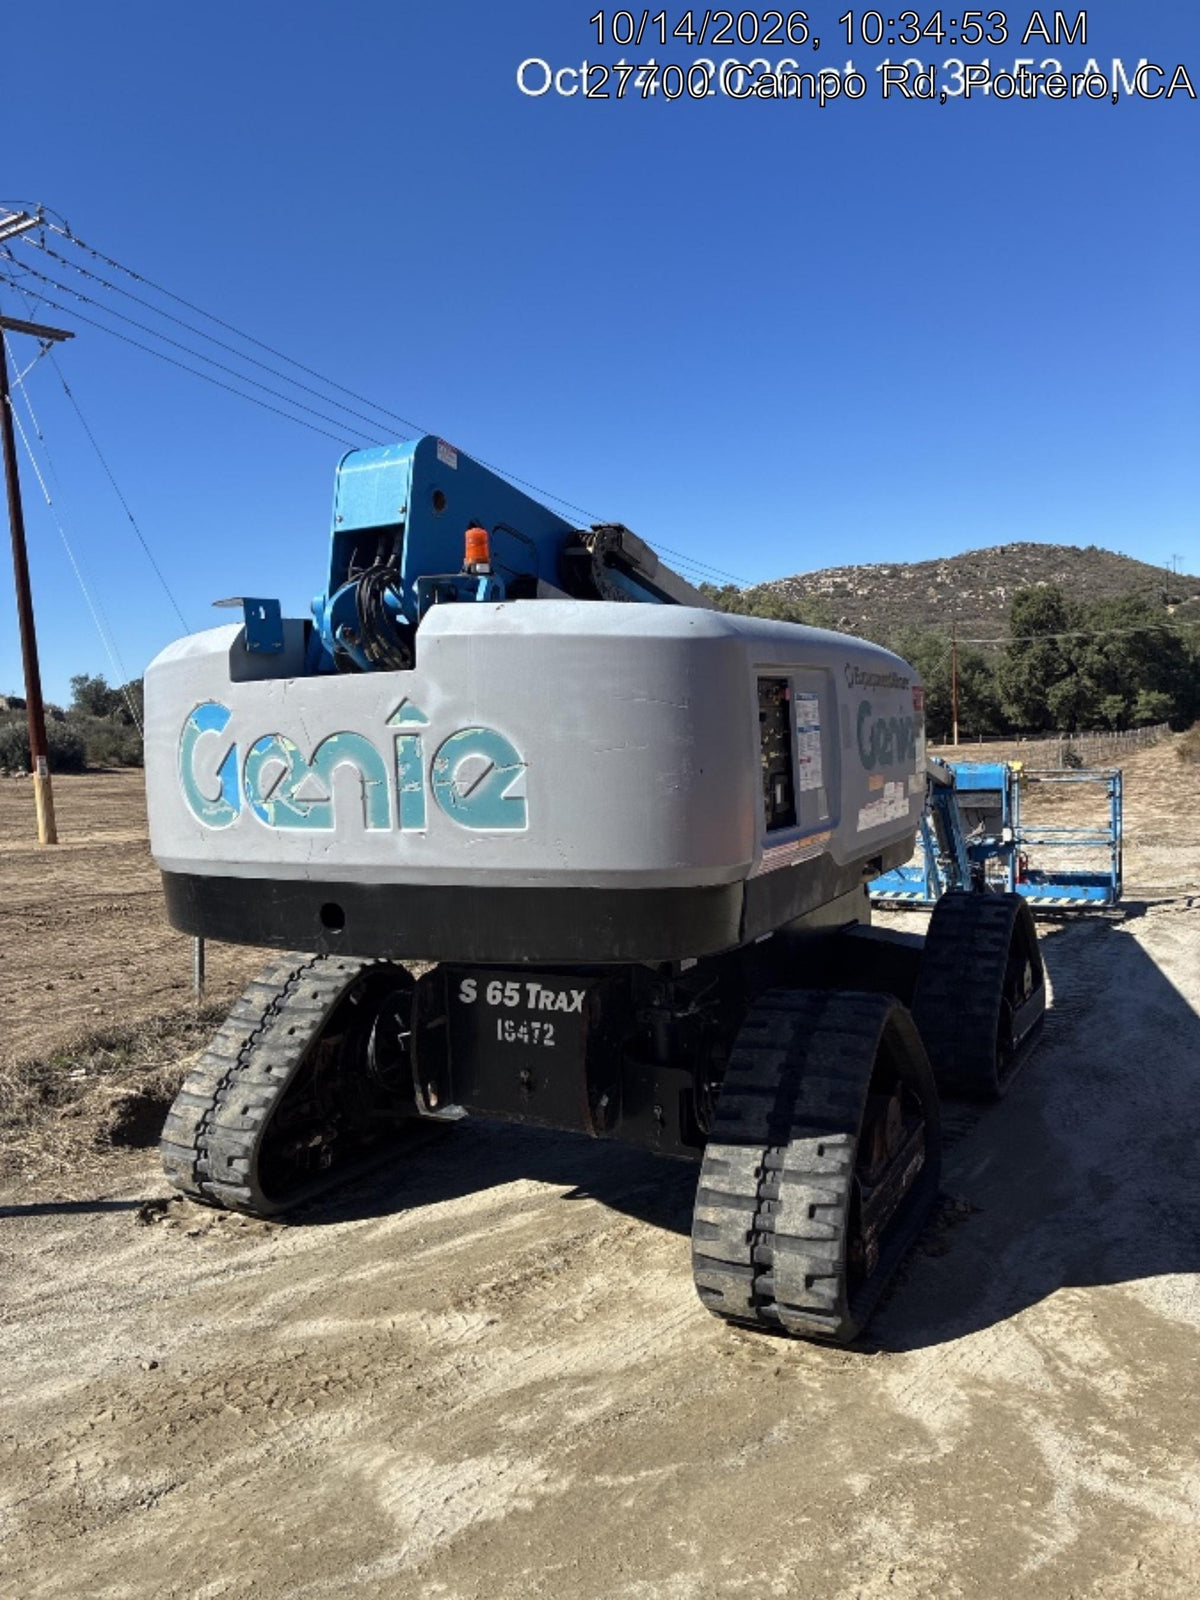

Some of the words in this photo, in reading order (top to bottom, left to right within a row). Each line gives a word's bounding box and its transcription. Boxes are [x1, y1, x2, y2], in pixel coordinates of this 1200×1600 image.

[179, 698, 530, 834] Genie
[459, 978, 478, 1003] S
[486, 980, 521, 1008] 65
